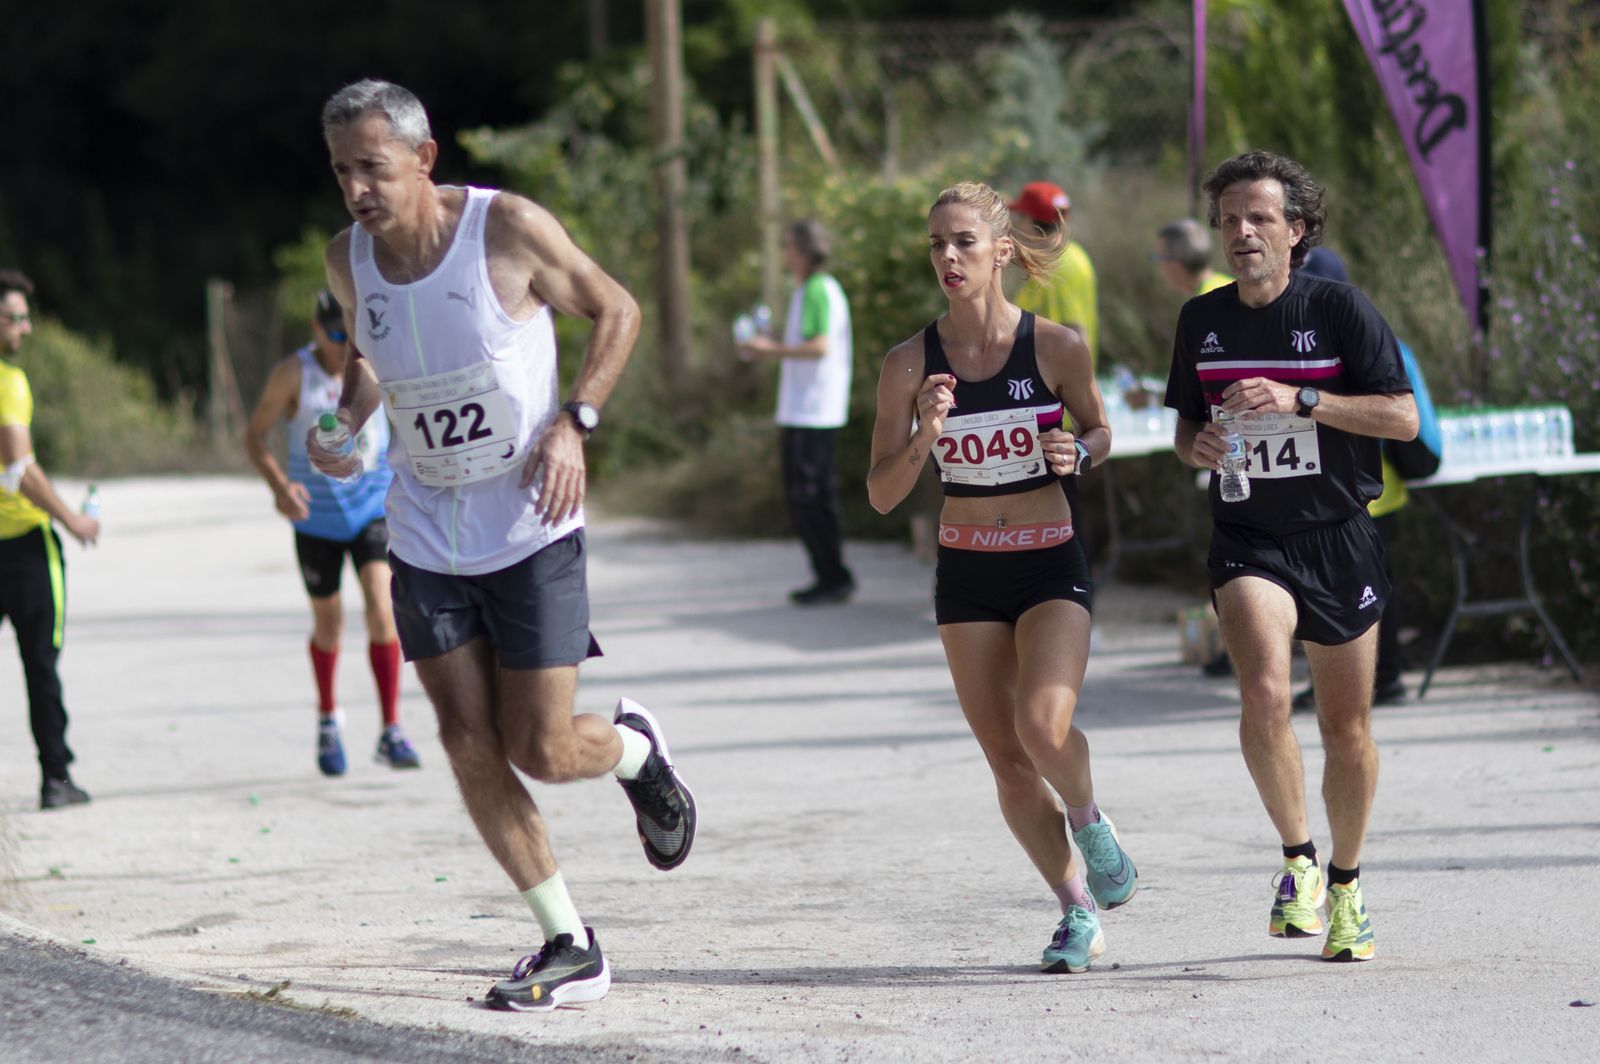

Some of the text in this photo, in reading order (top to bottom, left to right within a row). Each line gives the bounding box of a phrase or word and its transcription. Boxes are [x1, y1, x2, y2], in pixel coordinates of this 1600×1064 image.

[413, 402, 493, 450] 122
[937, 427, 1034, 464] 2049
[970, 529, 1036, 546] NIKE
